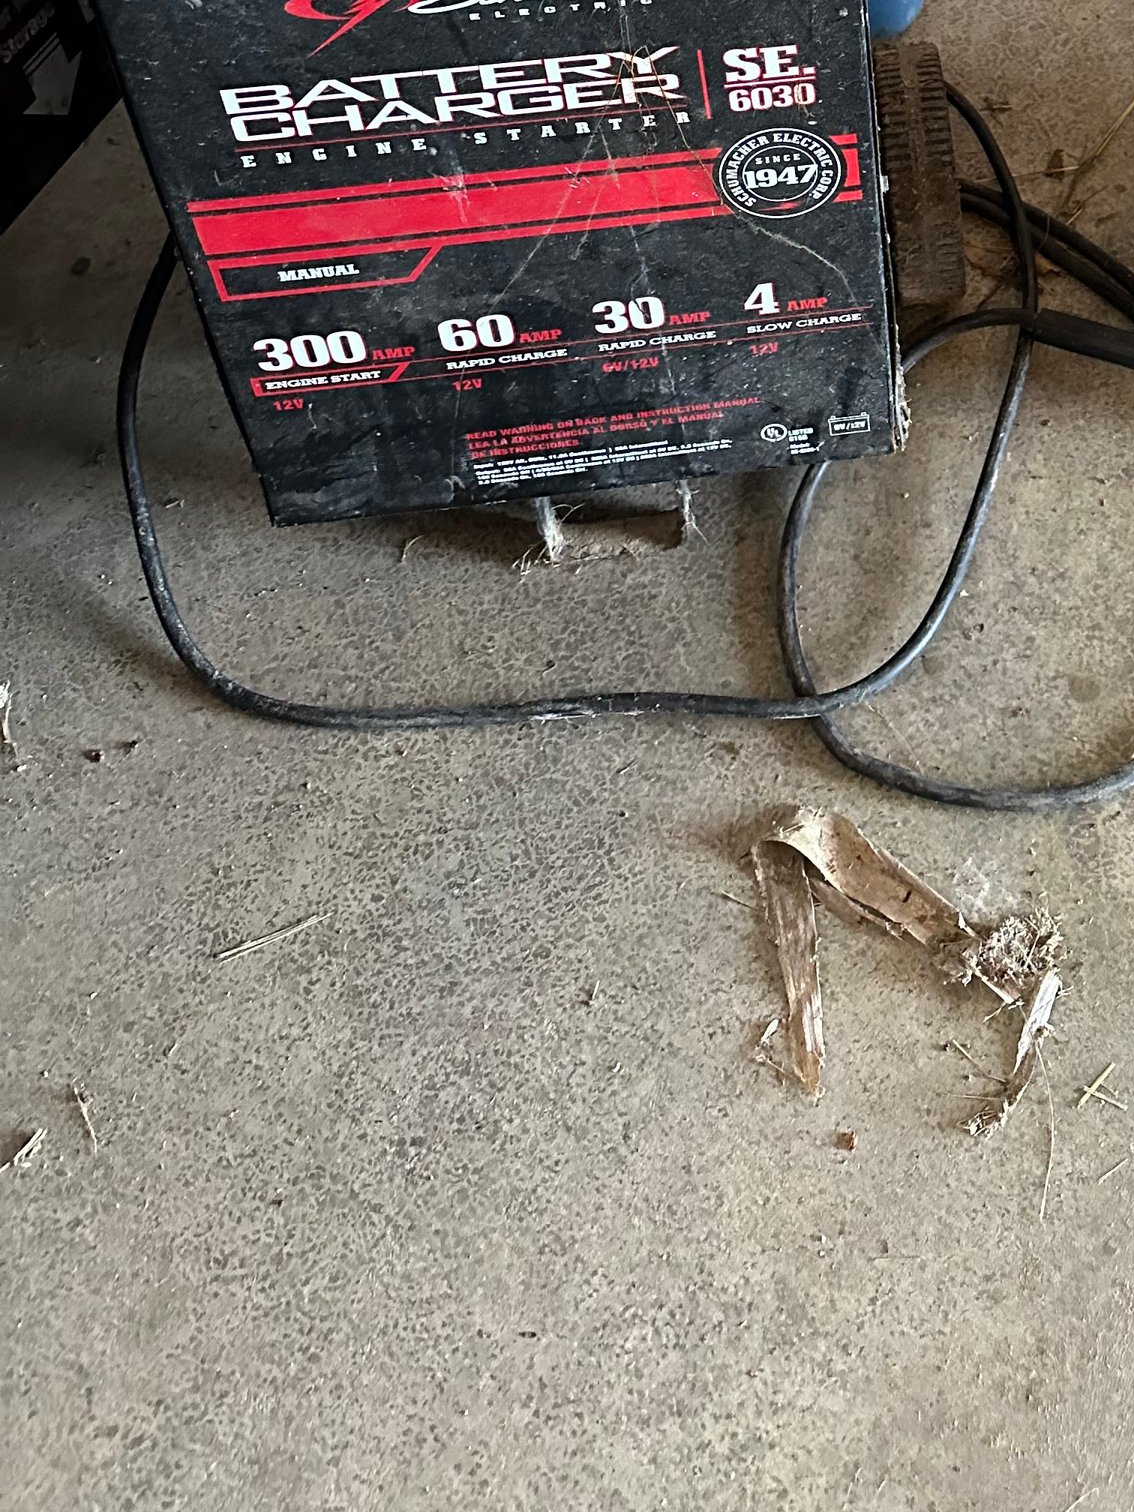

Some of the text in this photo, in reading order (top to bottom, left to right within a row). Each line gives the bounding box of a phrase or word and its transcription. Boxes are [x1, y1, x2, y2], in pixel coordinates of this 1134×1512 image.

[221, 46, 683, 116] BATTERY
[229, 73, 689, 143] CHARGER
[728, 82, 817, 112] 6030
[241, 111, 692, 168] ENGINE STARTER
[726, 131, 834, 207] SCHUMACHER ELECTRIC CORP.
[755, 153, 801, 165] SINCE
[743, 164, 819, 189] 1947
[278, 264, 360, 283] MANUAL
[743, 282, 829, 316] 4 AMP
[591, 295, 711, 335] 30 AMP
[746, 313, 863, 335] SLOW CHARGE
[437, 313, 563, 352] 60 AMP
[598, 330, 718, 353] RAPID CHARGE
[252, 330, 416, 372] 300 AMP
[446, 348, 568, 371] RAPID CHARGE
[750, 342, 780, 356] 12V
[265, 370, 381, 391] ENGINE START
[453, 378, 483, 392] 12V
[273, 398, 305, 411] 12V
[465, 396, 761, 440] READ WARNING ON BACK AND INSTRUCTION MANUAL
[469, 440, 491, 449] LEA
[493, 439, 508, 447] LA
[511, 429, 589, 444] ADVERTENCIA
[593, 426, 606, 434] AL
[662, 417, 675, 425] EL
[678, 411, 725, 424] MANUAL
[471, 439, 580, 460] DE INSTRUCCIONES
